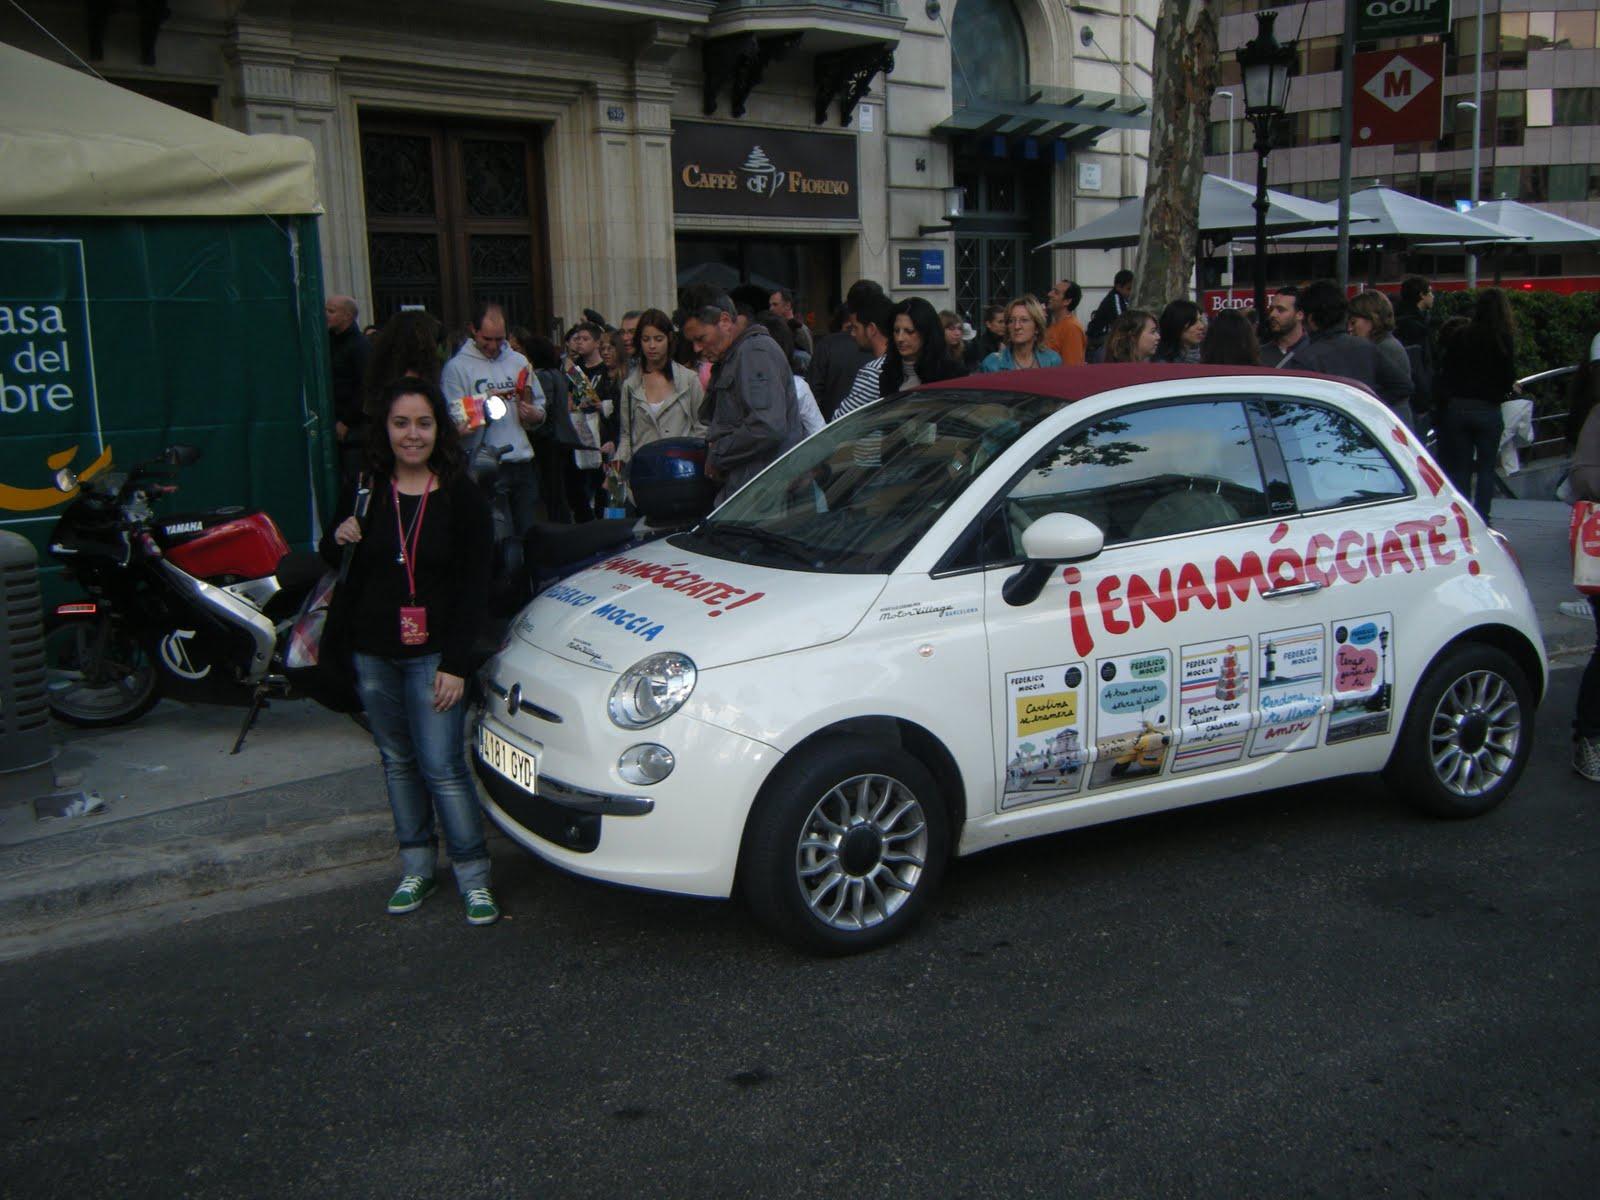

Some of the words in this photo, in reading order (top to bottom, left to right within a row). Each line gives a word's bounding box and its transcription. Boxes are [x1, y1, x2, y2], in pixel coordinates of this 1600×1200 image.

[1383, 69, 1412, 98] M
[788, 170, 849, 196] FIORINO
[1213, 295, 1256, 311] Banc
[14, 340, 71, 373] del
[165, 521, 204, 535] YAMAHA
[1063, 502, 1480, 657] ¡ENAMÓCCIATE!
[591, 603, 665, 642] MOCCIA
[1283, 647, 1317, 660] FEDERICO
[1291, 655, 1318, 665] MOCCIA
[1130, 658, 1164, 670] FEDERICO
[1186, 657, 1217, 668] FEDERICO
[1138, 665, 1166, 675] MOCCIA
[1187, 667, 1213, 677] MOCCIA
[1011, 674, 1044, 685] FEDERICO
[1018, 683, 1045, 692] MOCCIA
